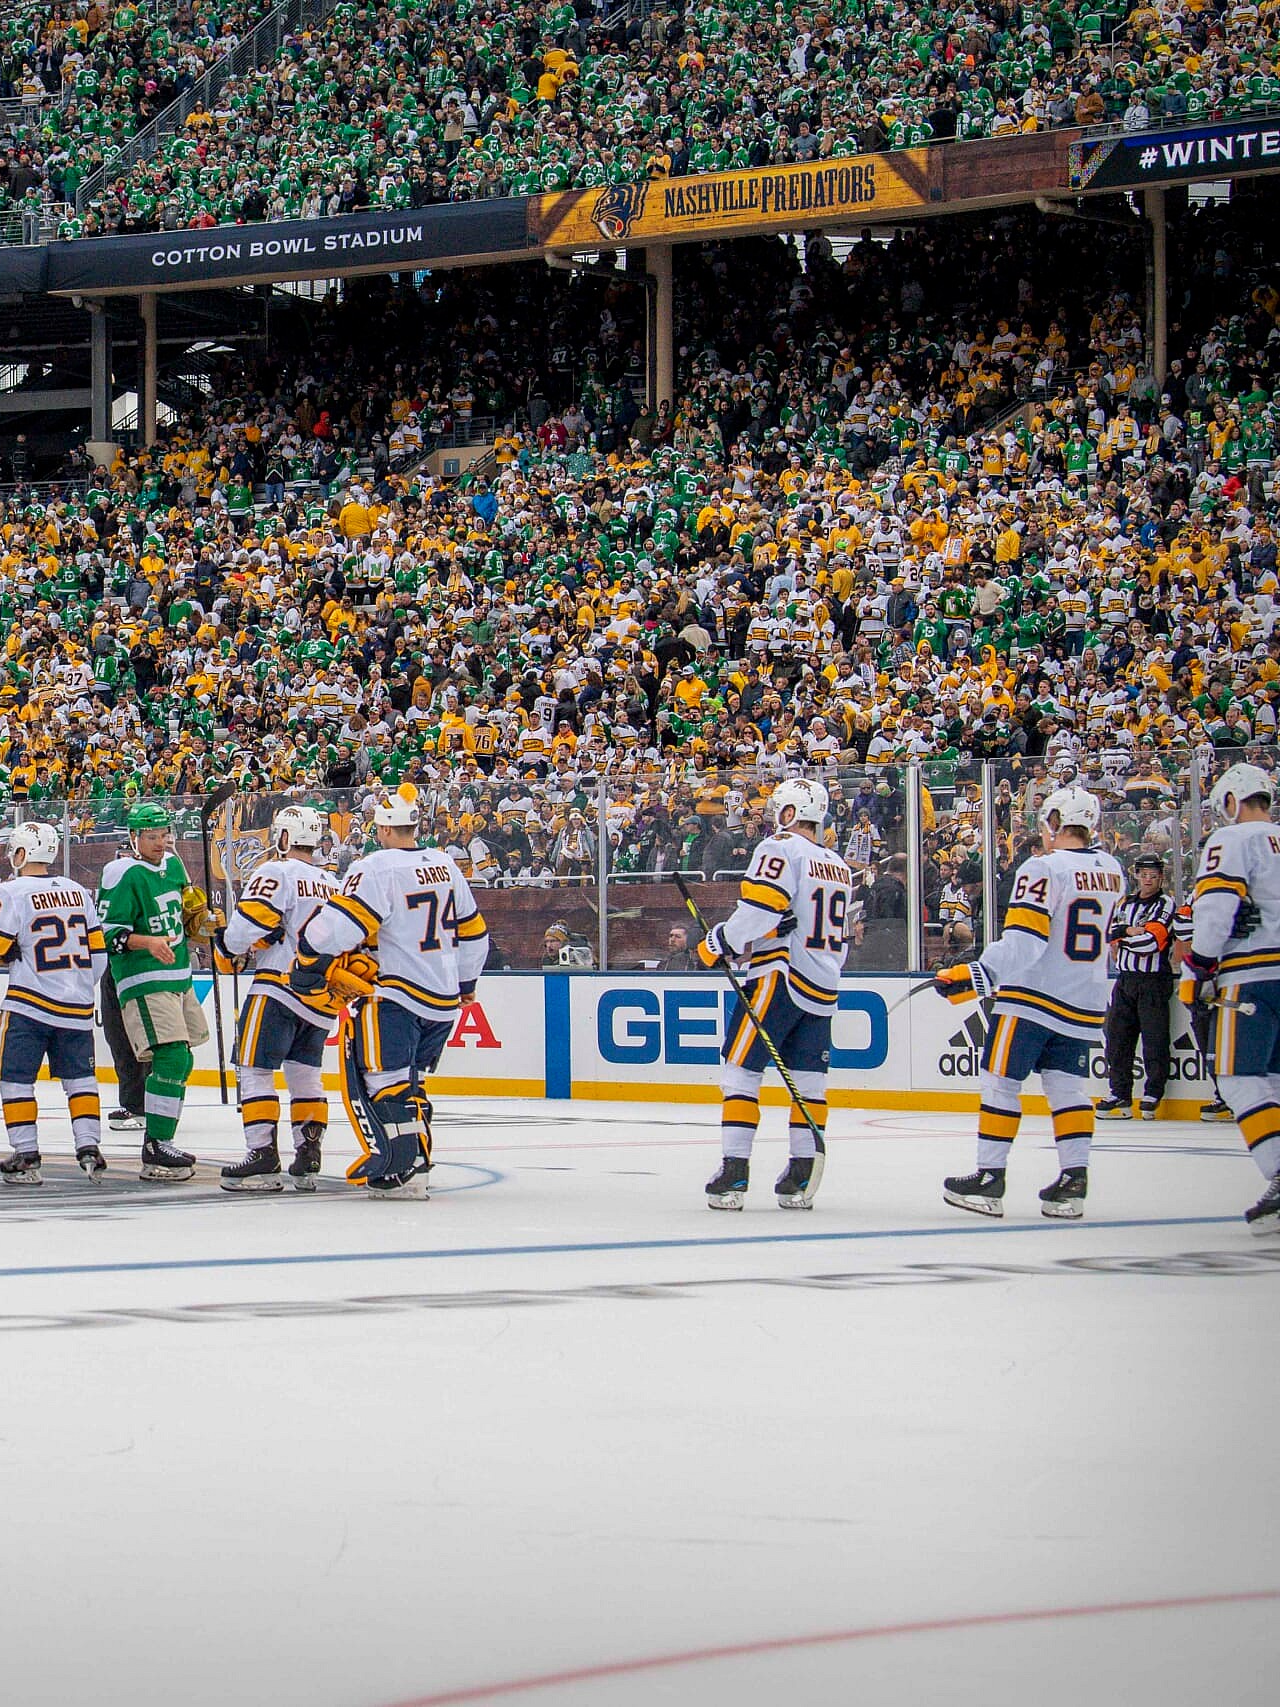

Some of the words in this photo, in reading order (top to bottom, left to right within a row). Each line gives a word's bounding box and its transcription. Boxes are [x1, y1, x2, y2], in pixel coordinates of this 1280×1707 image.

[664, 178, 758, 218] NASHVILLE
[760, 163, 875, 213] PREDATORS
[151, 244, 241, 268] COTTON
[248, 238, 316, 259] BOWL
[323, 225, 424, 251] STADIUM
[415, 865, 450, 885] SAROS
[755, 854, 785, 880] 19
[1206, 844, 1223, 872] 5
[31, 891, 84, 910] GRIMALDI
[249, 876, 279, 898] 42
[1015, 875, 1049, 903] 64
[405, 888, 459, 952] 74
[805, 886, 846, 952] 19
[31, 914, 92, 972] 23
[597, 988, 889, 1070] GEO
